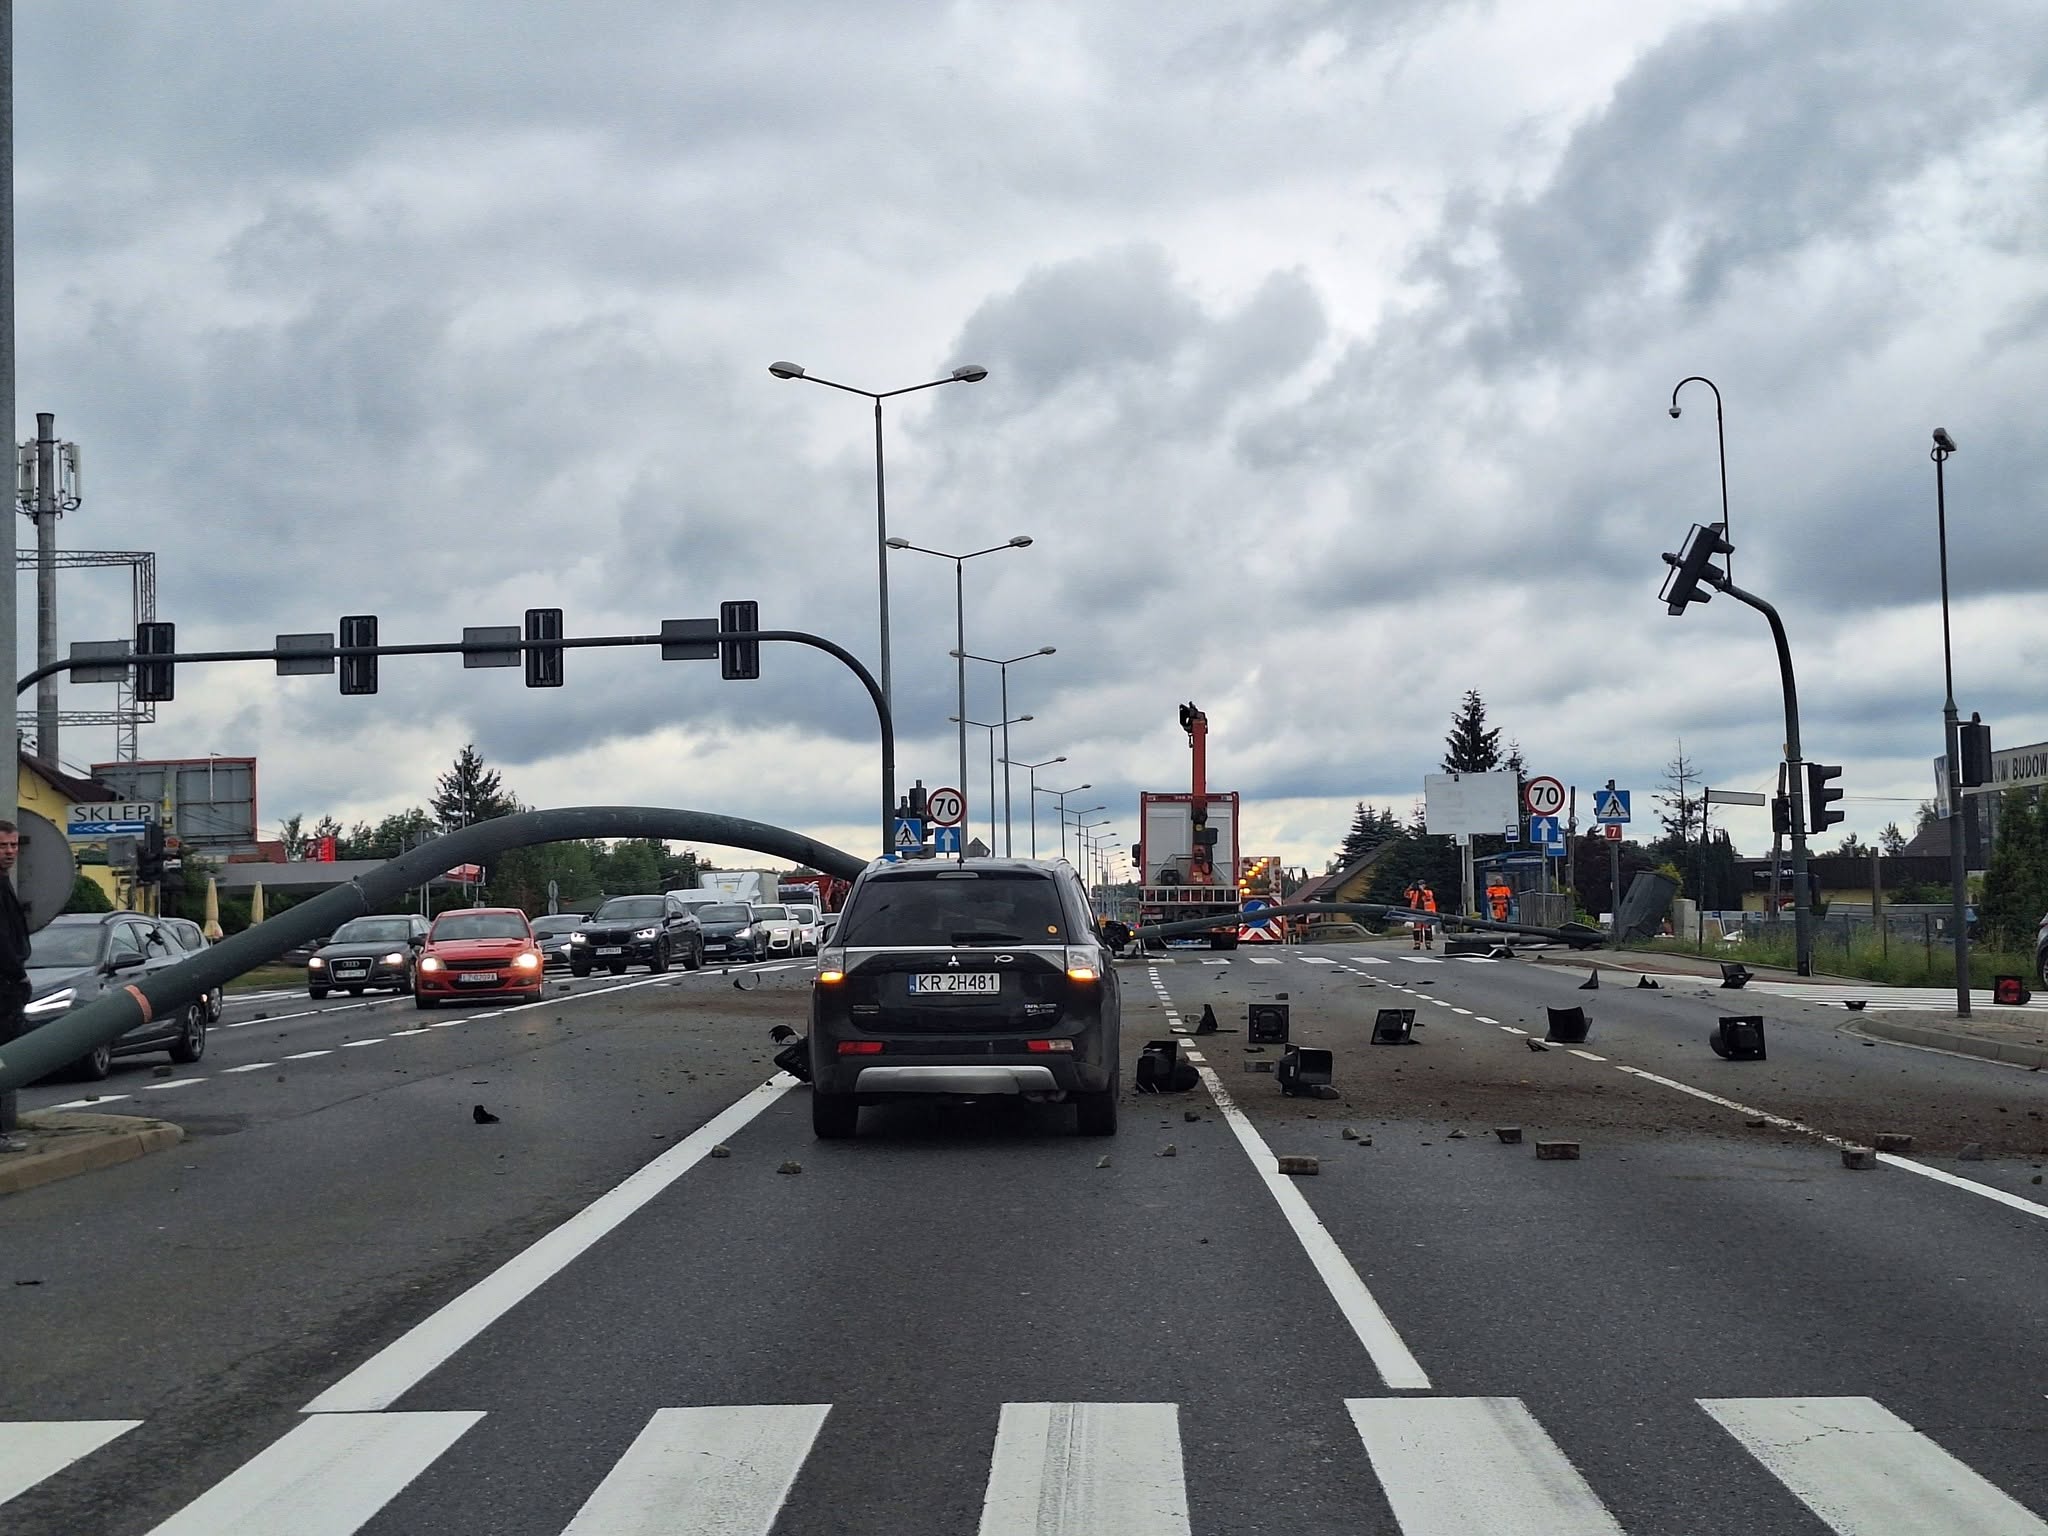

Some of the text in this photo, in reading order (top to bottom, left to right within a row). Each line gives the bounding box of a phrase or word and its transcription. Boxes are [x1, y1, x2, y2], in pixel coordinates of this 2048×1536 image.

[2012, 752, 2048, 780] BUDOW
[1533, 787, 1559, 805] 70
[74, 805, 151, 822] SKLEP
[934, 798, 960, 817] 70
[1610, 826, 1617, 837] 7
[918, 974, 995, 991] KR 2H481
